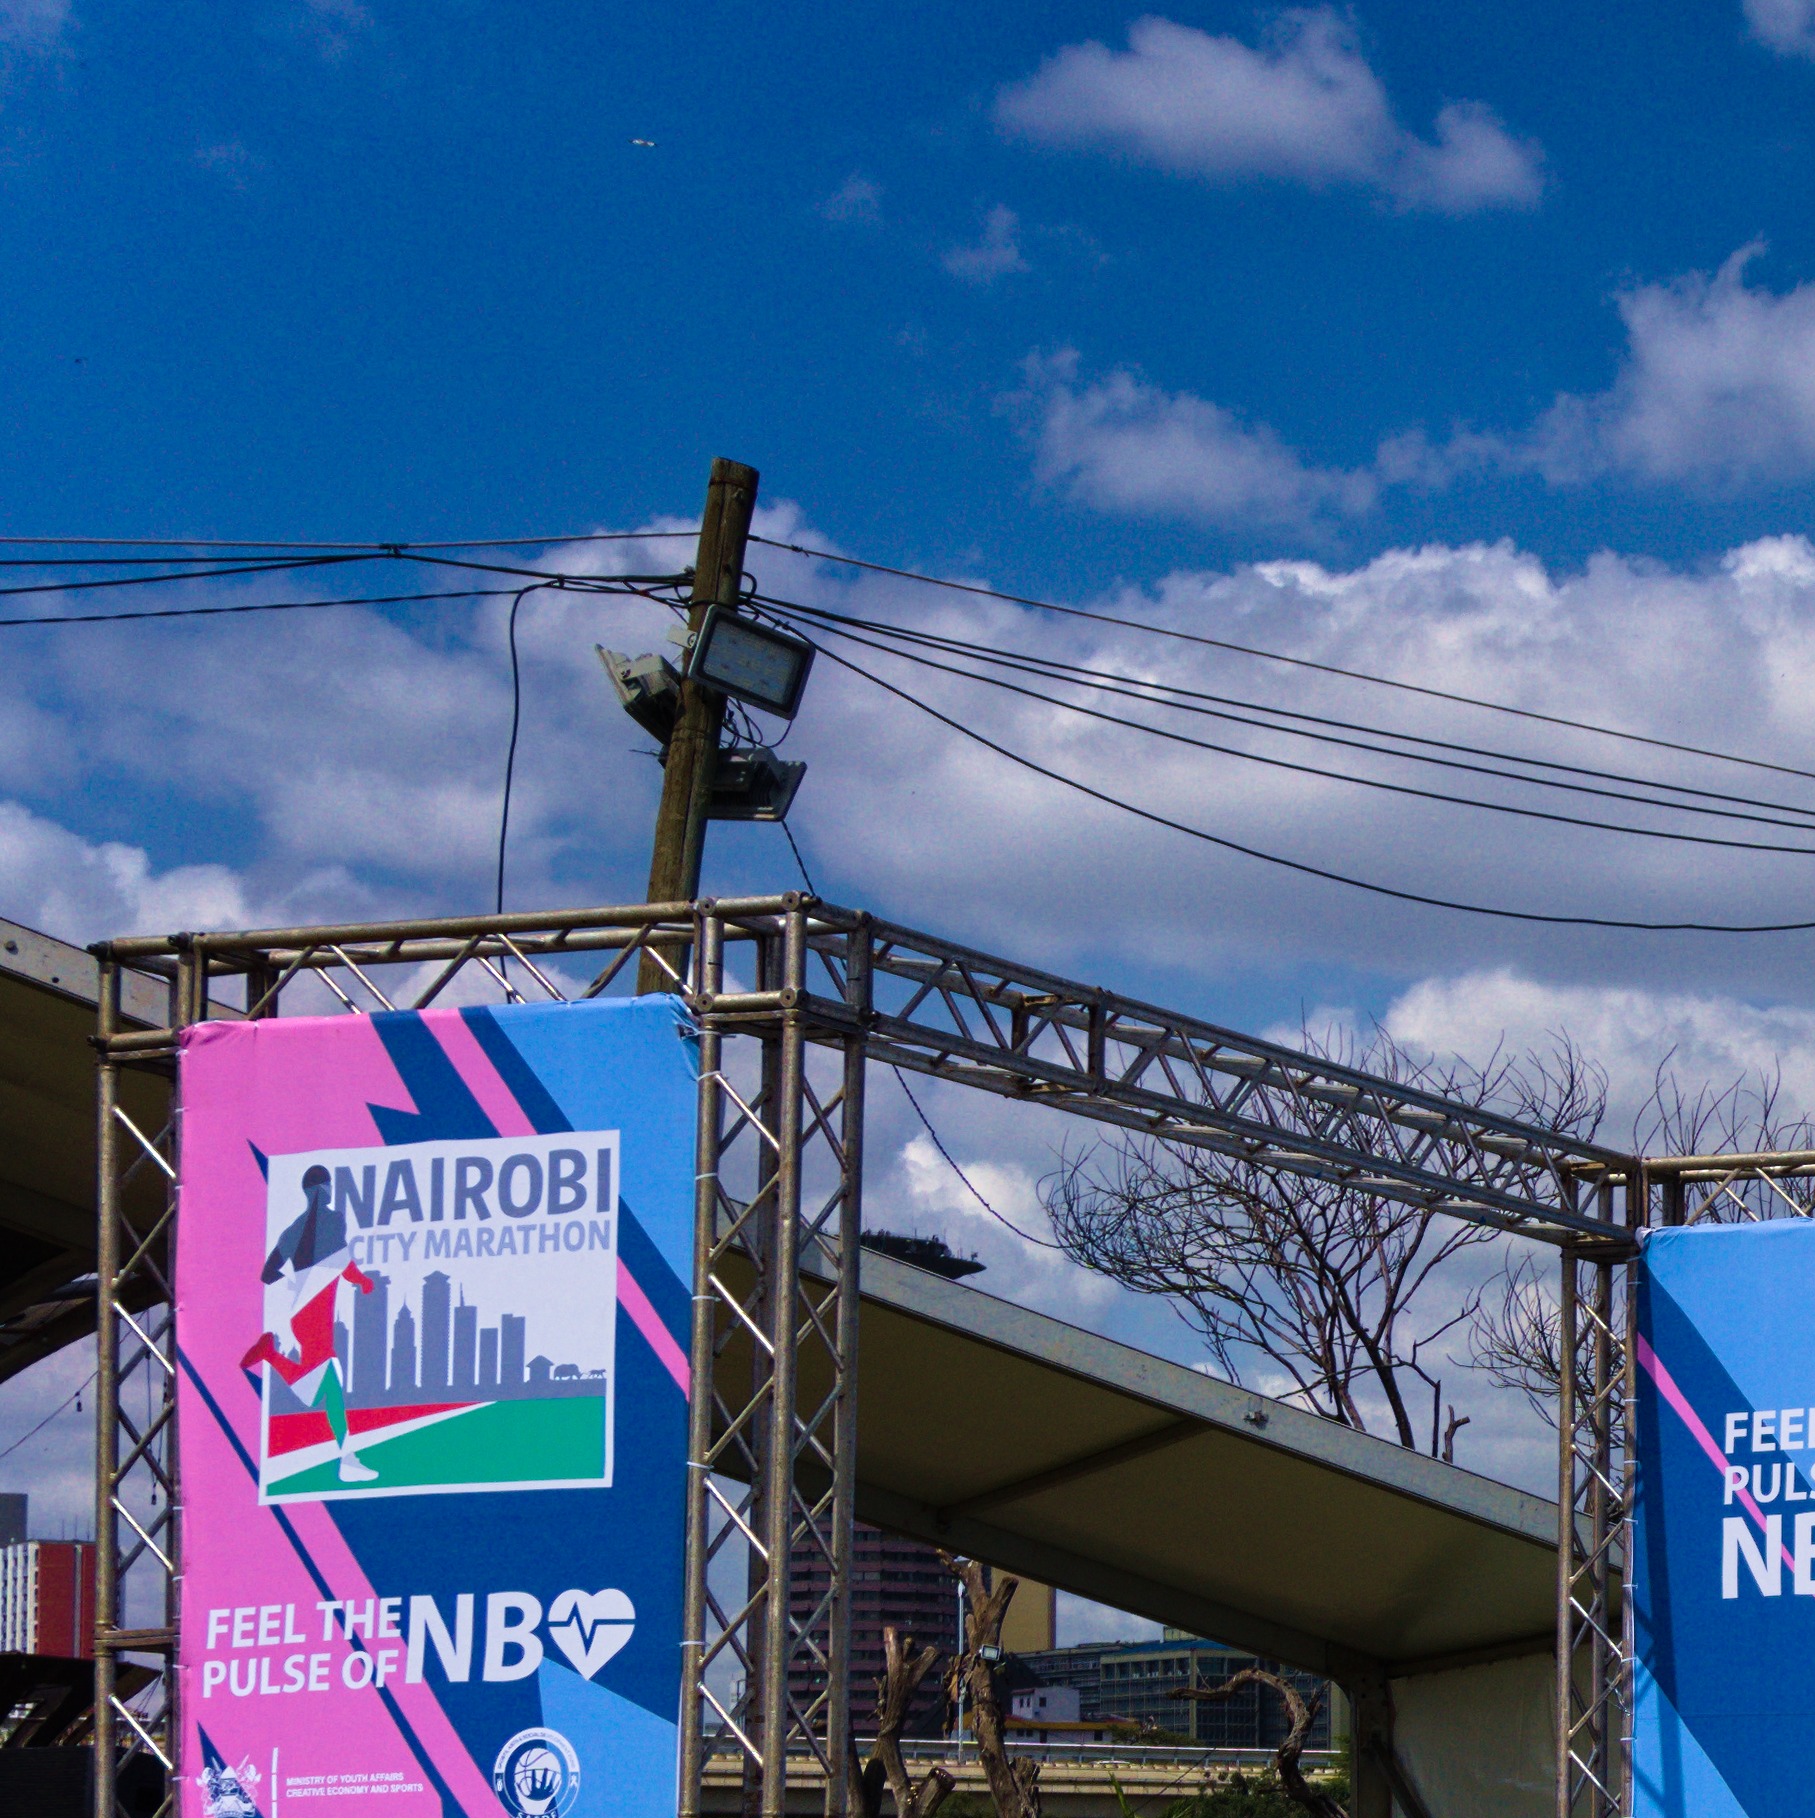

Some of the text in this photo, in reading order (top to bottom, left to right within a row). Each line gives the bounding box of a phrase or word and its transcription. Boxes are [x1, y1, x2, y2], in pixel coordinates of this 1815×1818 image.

[334, 1148, 611, 1230] NAIROBI
[348, 1220, 611, 1264] CITY MARATHON
[206, 1597, 401, 1649] FEEL THE
[202, 1650, 398, 1698] PULSE OF
